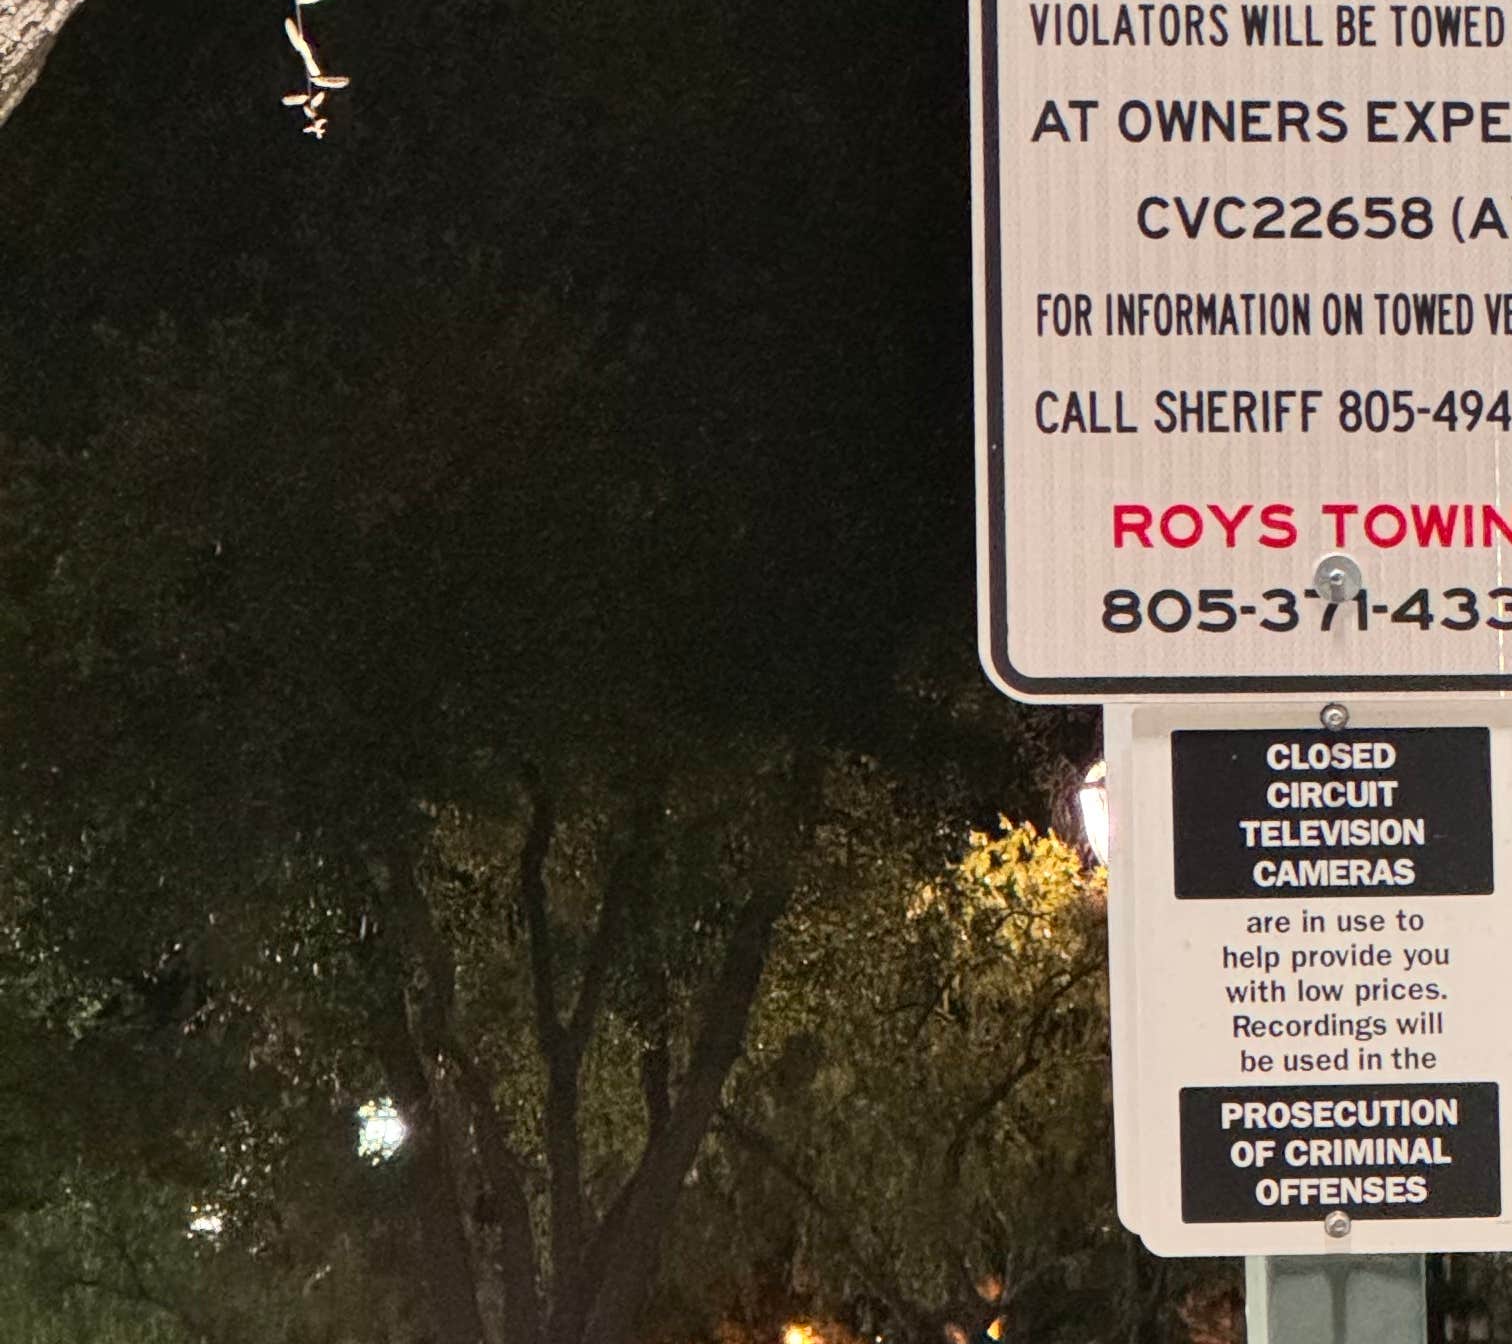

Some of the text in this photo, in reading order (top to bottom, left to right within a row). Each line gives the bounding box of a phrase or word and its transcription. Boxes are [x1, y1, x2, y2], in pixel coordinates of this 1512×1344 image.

[1029, 3, 1229, 47] VIOLATORS
[1241, 4, 1324, 47] WILL
[1336, 4, 1377, 47] BE
[1389, 5, 1505, 48] TOWED
[1030, 99, 1099, 143] AT
[1118, 99, 1348, 144] OWNERS
[1137, 196, 1434, 240] CVC22658
[1036, 292, 1092, 337] FOR
[1106, 292, 1311, 337] INFORMATION
[1322, 292, 1363, 337] ON
[1373, 292, 1474, 336] TOWED
[1035, 390, 1138, 434] CALL
[1154, 389, 1323, 434] SHERIFF
[1112, 501, 1299, 550] ROYS
[1266, 742, 1397, 771] CLOSED
[1266, 780, 1399, 809] CIRCUIT
[1239, 818, 1425, 848] TELEVISION
[1253, 858, 1416, 888] CAMERAS
[1246, 909, 1424, 934] are in use to
[1222, 943, 1449, 974] help provide you
[1225, 979, 1447, 1007] with low prices.
[1233, 1012, 1443, 1042] Recordings will
[1240, 1047, 1437, 1072] be used in the
[1221, 1098, 1458, 1130] PROSECUTION
[1230, 1137, 1452, 1168] OF CRIMINAL
[1255, 1175, 1428, 1206] OFFENSES
